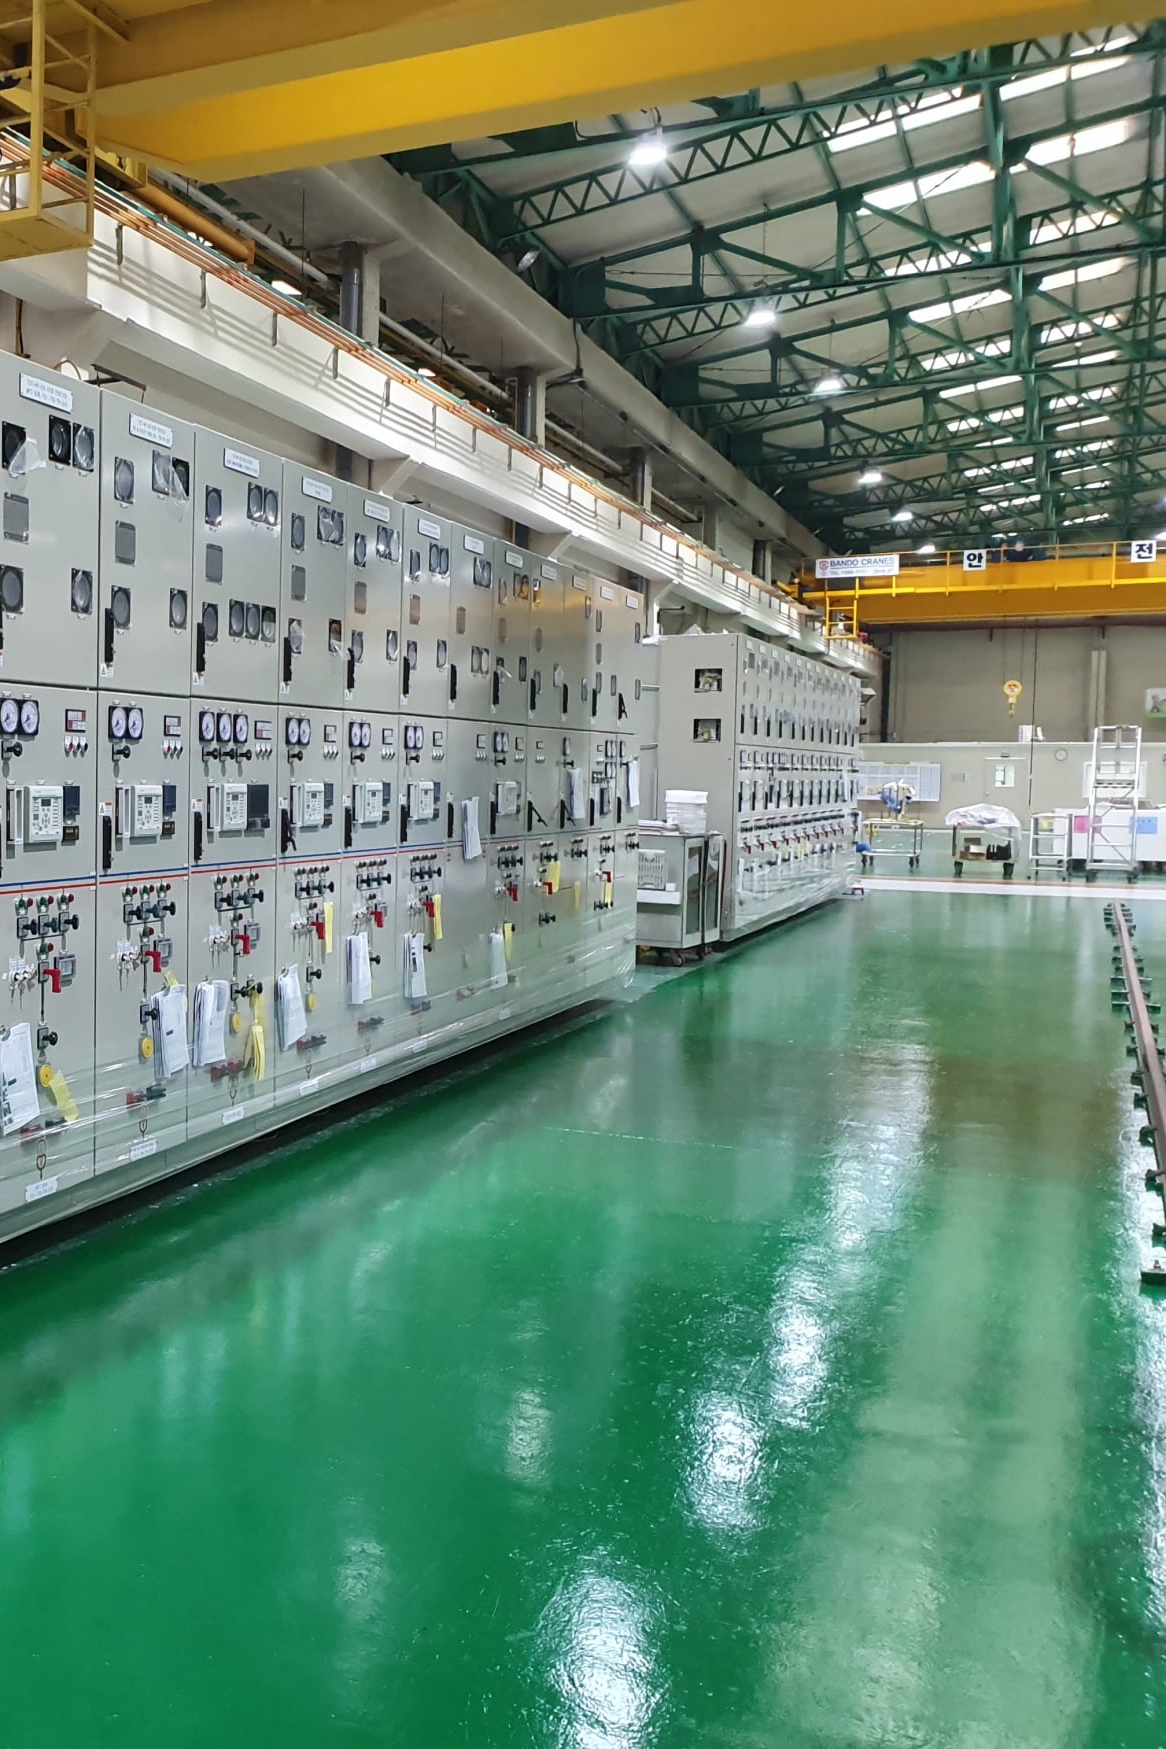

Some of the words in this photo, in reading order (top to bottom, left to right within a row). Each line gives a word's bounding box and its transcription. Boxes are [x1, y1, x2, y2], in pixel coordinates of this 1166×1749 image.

[829, 558, 859, 568] BANDO
[860, 557, 895, 567] CRANES
[966, 552, 983, 568] 안
[1135, 542, 1153, 559] 전
